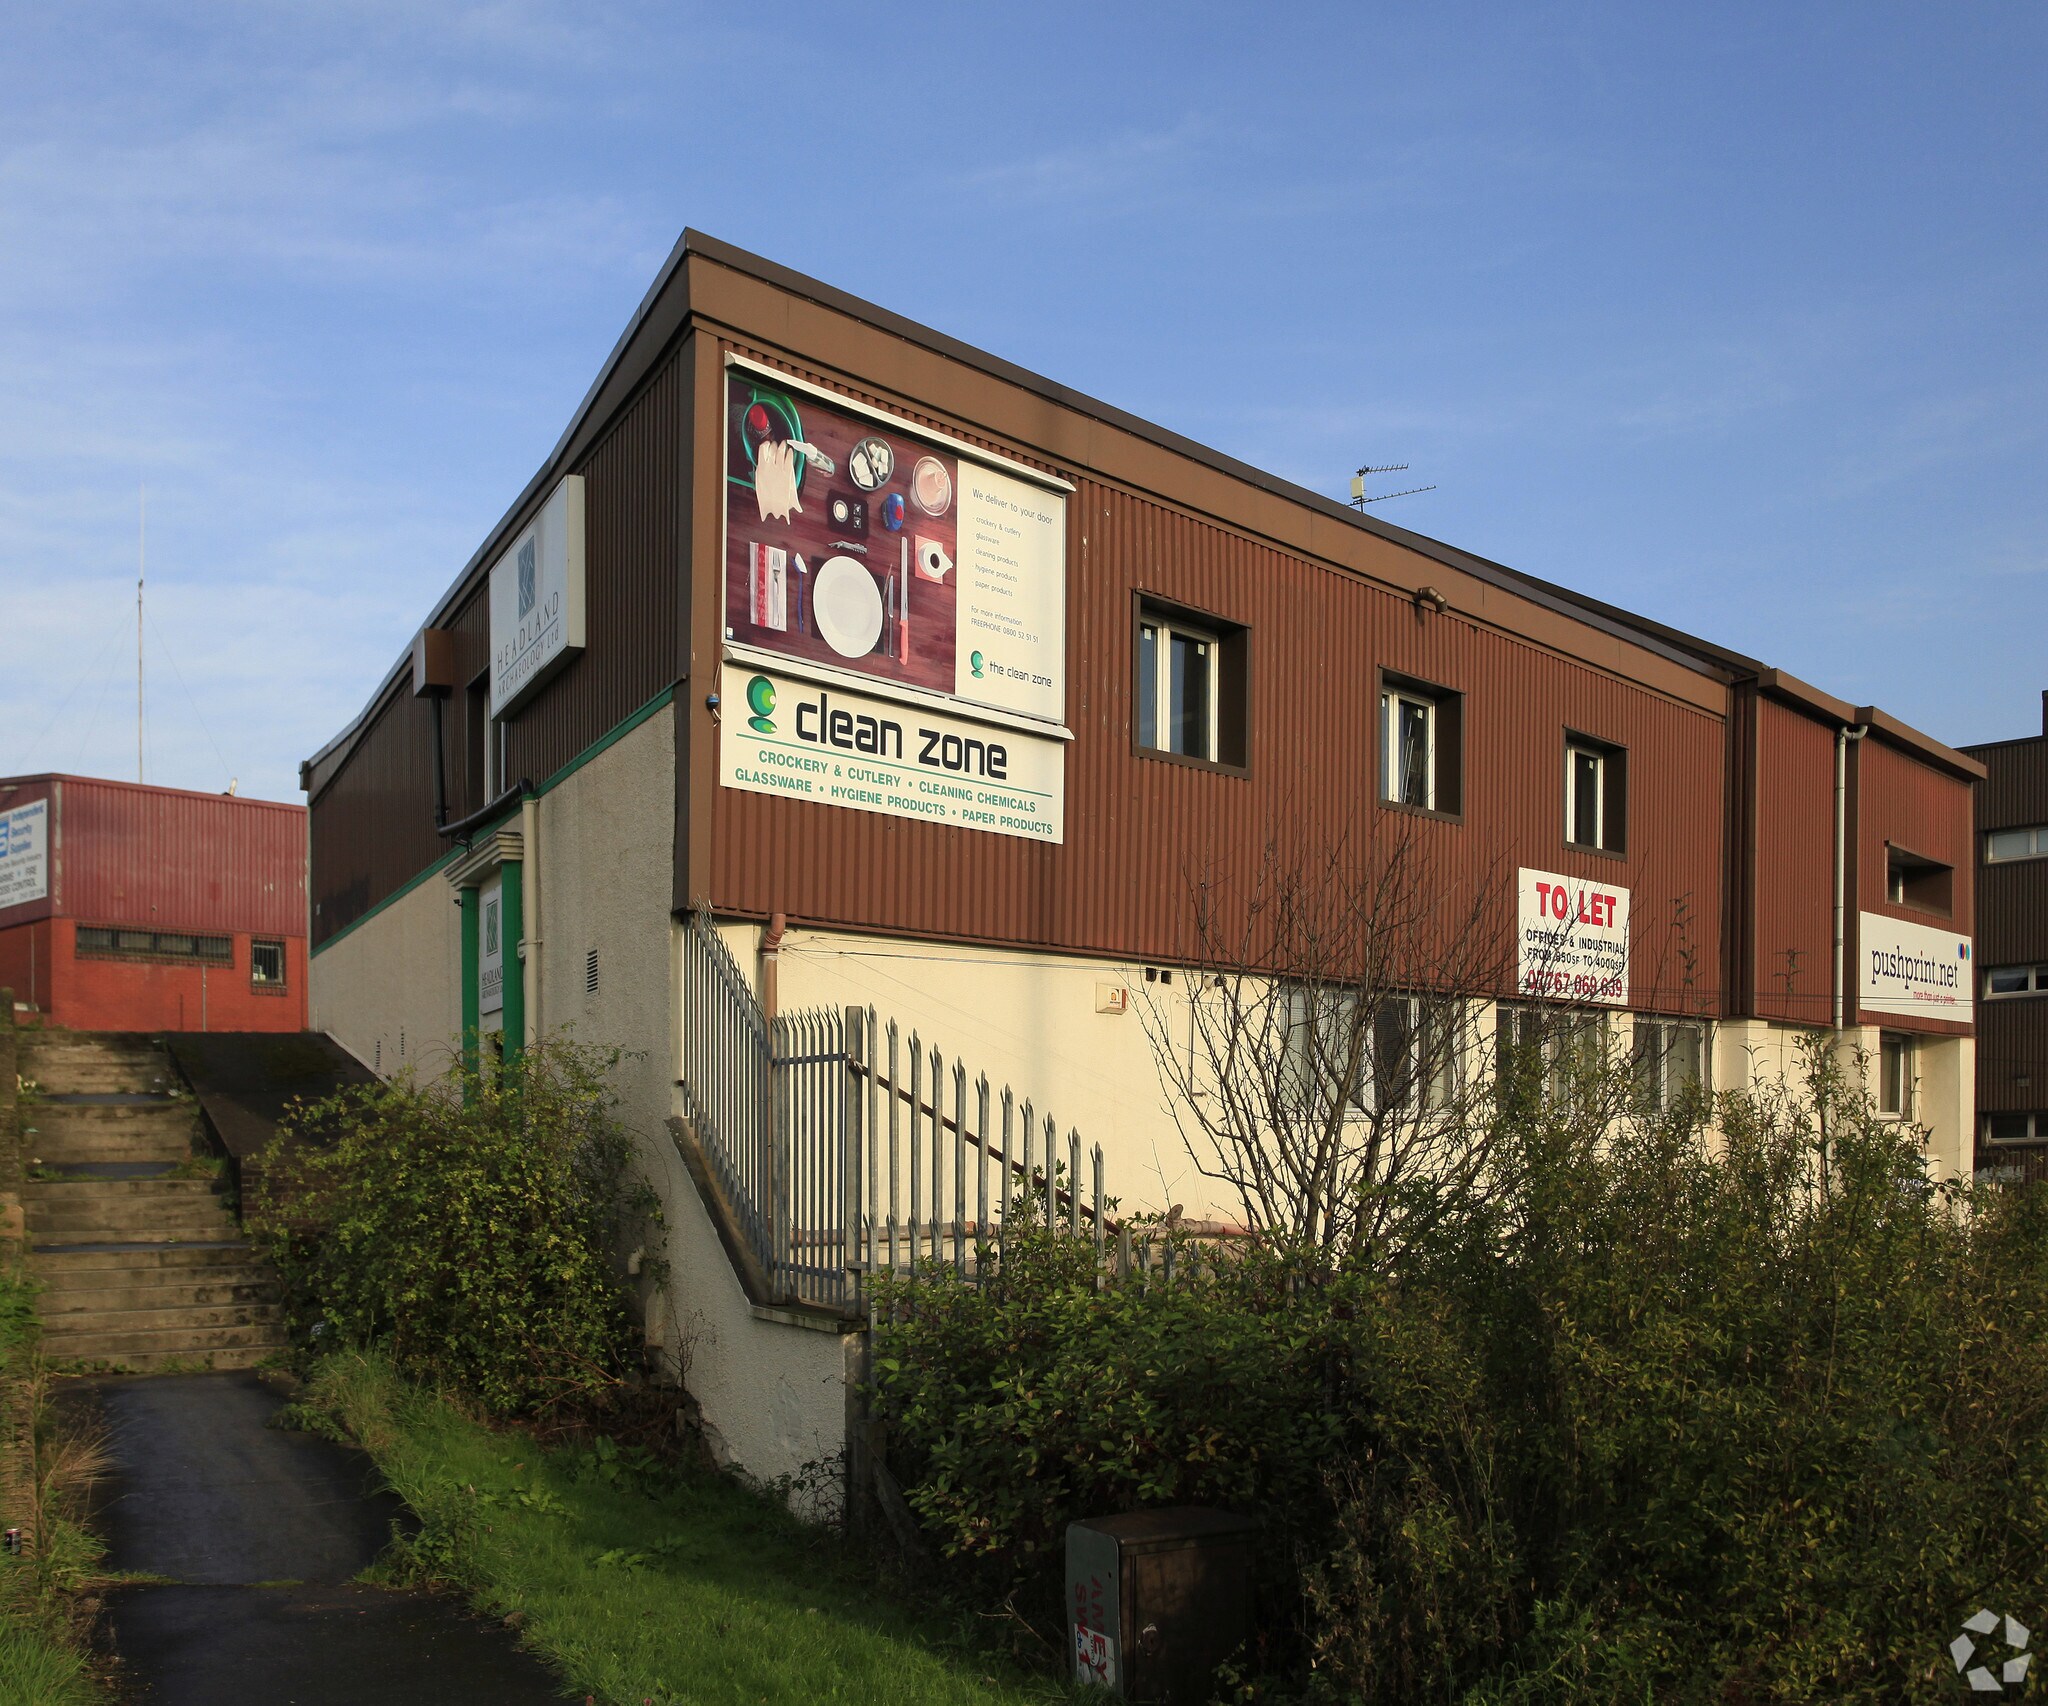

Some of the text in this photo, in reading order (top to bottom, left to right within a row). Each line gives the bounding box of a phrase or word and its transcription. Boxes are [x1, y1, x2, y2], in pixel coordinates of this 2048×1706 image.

[972, 488, 1053, 525] We deliver to your door
[975, 531, 1000, 546] glassware
[976, 515, 1022, 539] crockery & cutlery
[975, 547, 1019, 568] cleaning products
[975, 562, 1018, 583] hygiene products
[974, 579, 1013, 597] paper products
[970, 617, 1002, 634] FREEPHONE
[1002, 626, 1017, 638] 0800
[971, 604, 1023, 627] For more information
[497, 591, 559, 674] HEADLAND
[497, 623, 559, 698] ARCHAEOLOGY Ltd
[989, 661, 1053, 688] the clean zone
[795, 693, 1008, 780] clean zone
[758, 750, 1036, 813] CROCKERY & CUTLERY CLEANING CHEMICALS
[735, 767, 1053, 835] GLASSWARE HYGIENE PRODUCTS PAPER PRODUCTS
[1536, 882, 1617, 928] TO LET
[1526, 929, 1624, 955] OFFICES & INDUSTRIAL
[1583, 955, 1593, 967] TO
[1871, 945, 1958, 990] pushprint.net
[1091, 1574, 1108, 1681] AMEY
